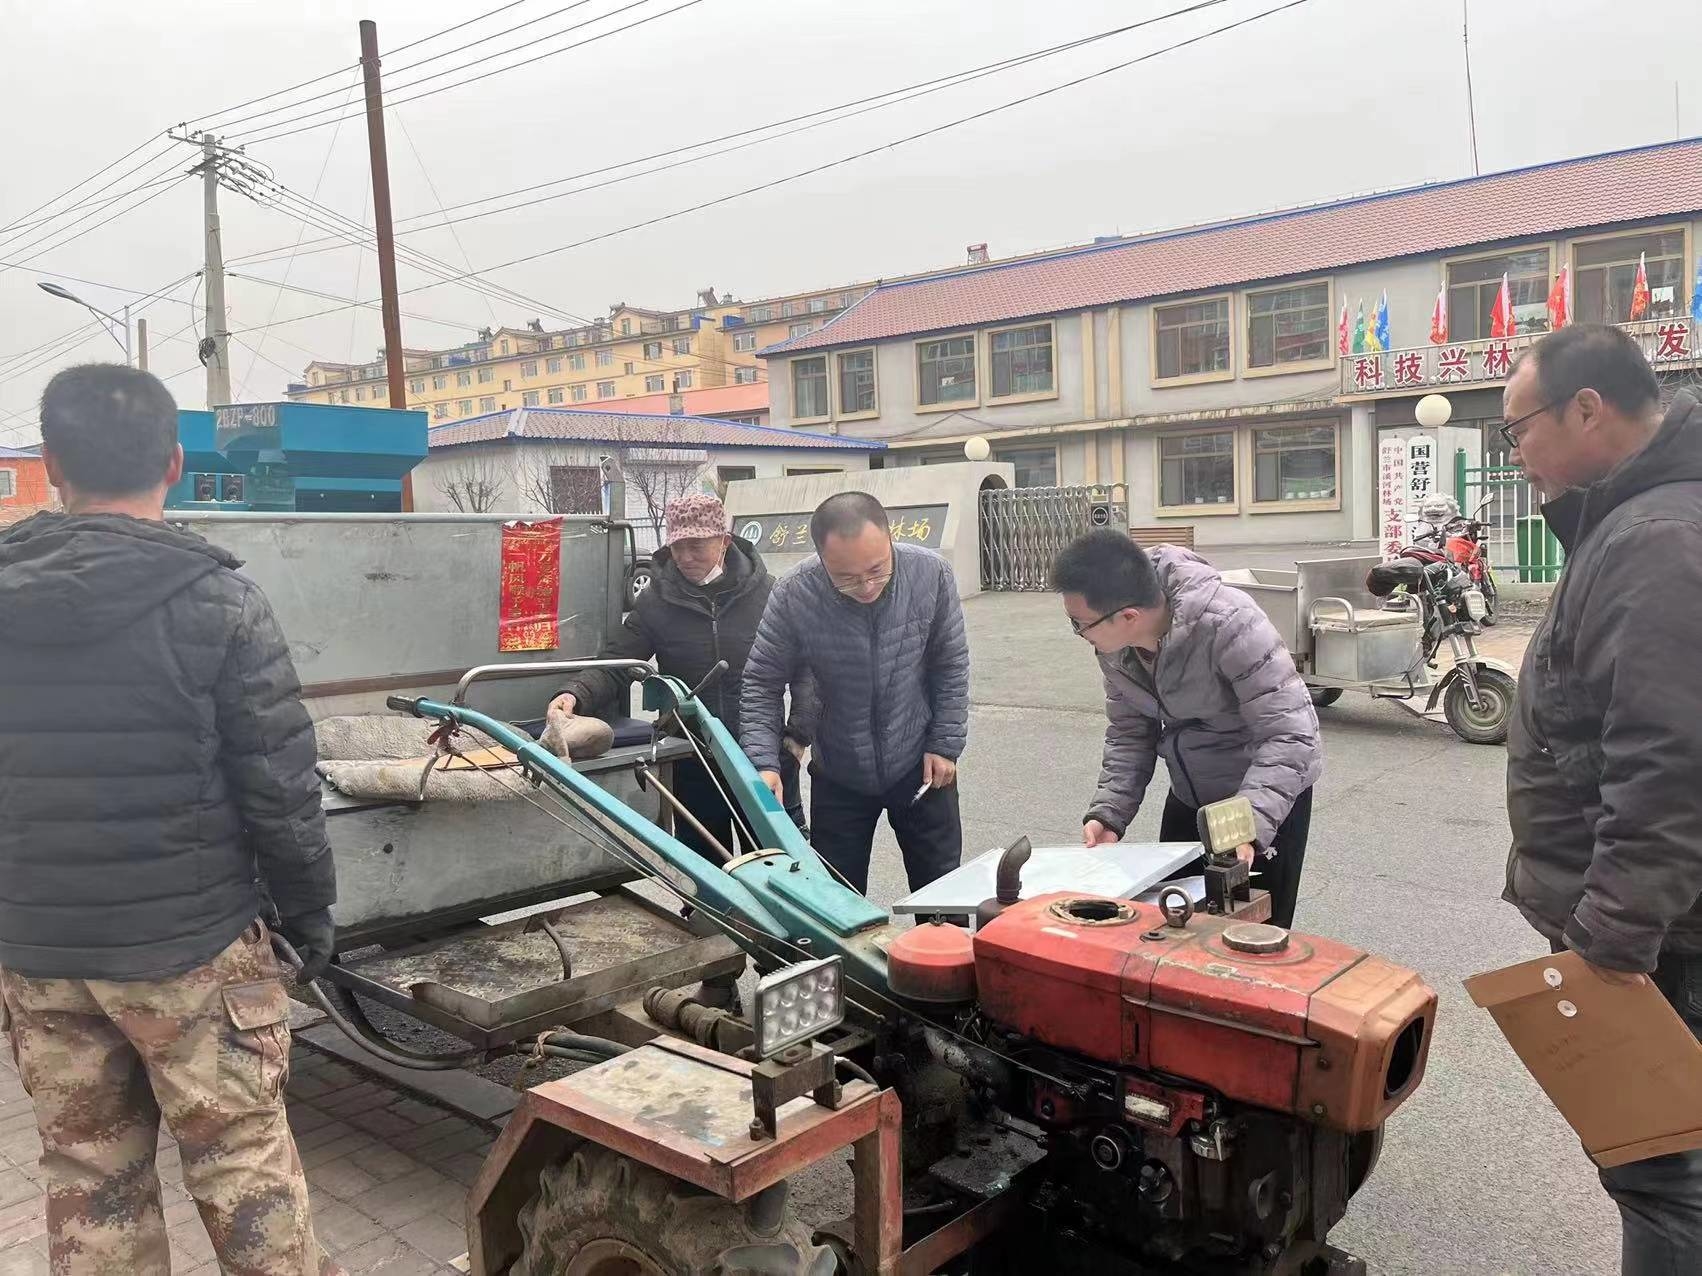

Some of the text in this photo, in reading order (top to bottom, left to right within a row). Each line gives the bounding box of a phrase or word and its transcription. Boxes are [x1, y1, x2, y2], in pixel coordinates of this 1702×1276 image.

[1354, 322, 1691, 388] 科技兴林 发
